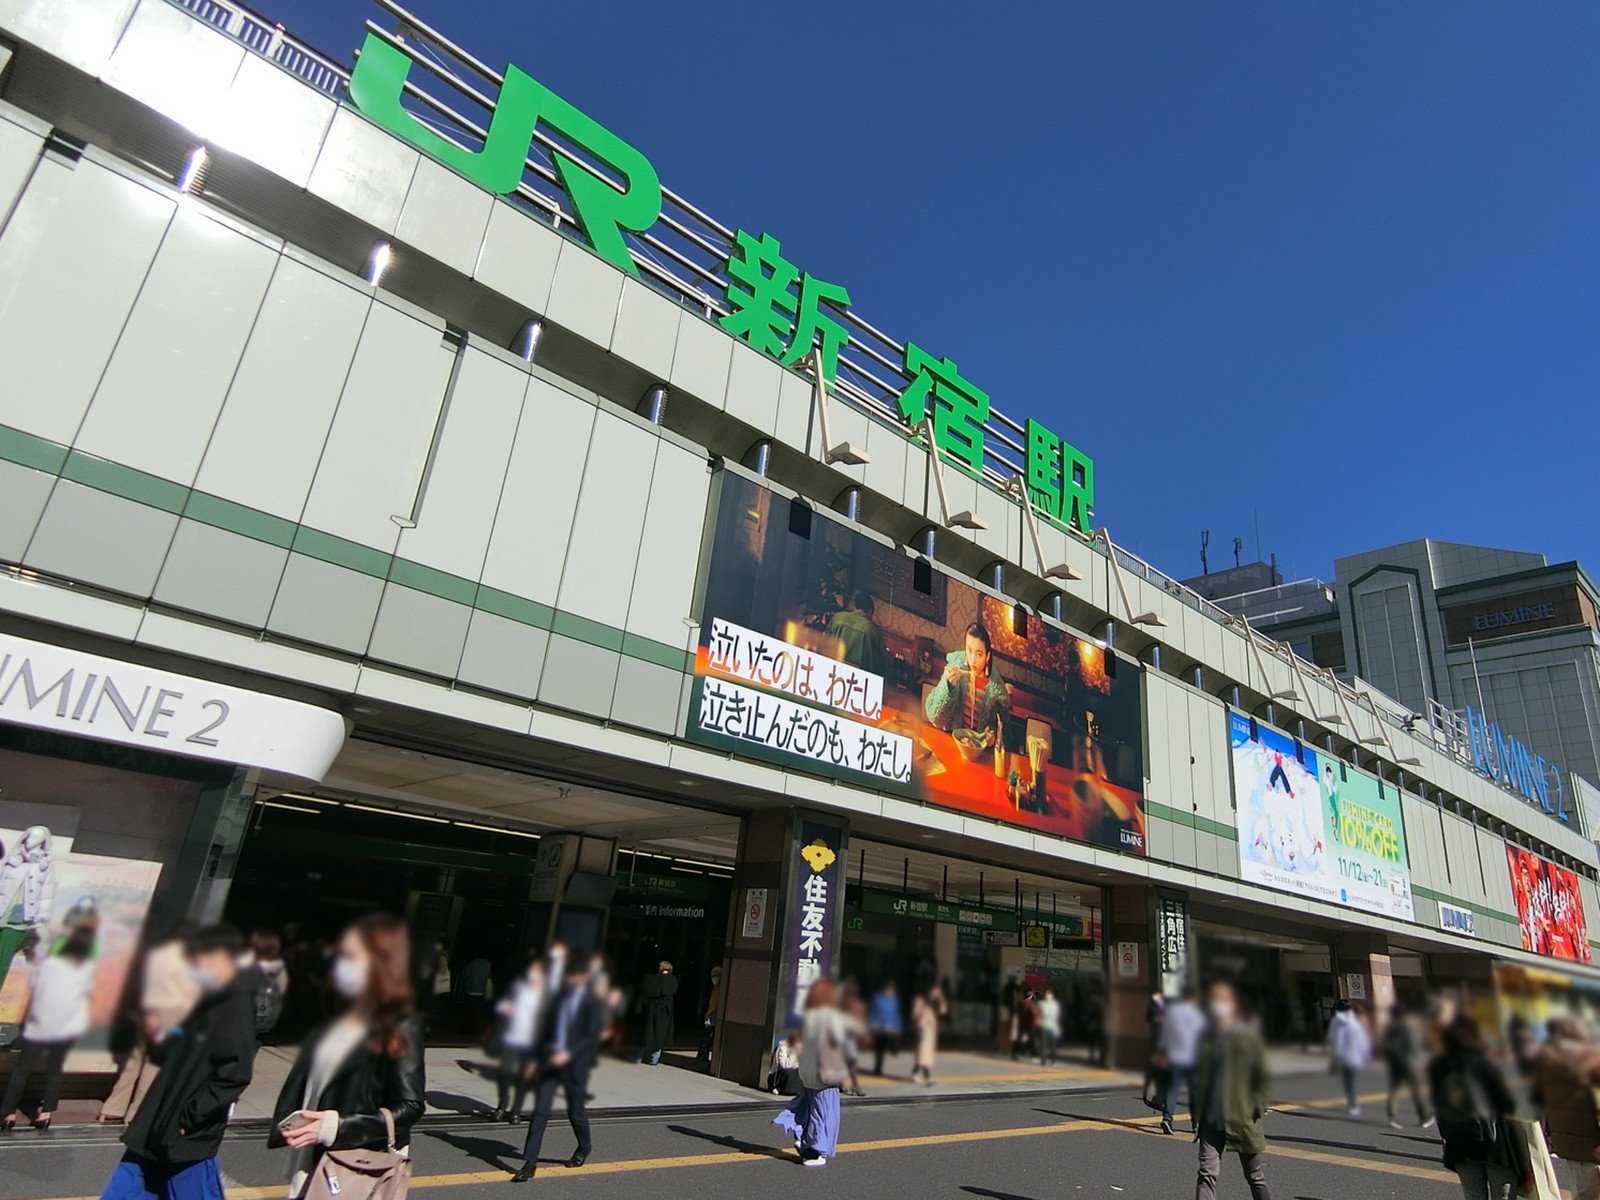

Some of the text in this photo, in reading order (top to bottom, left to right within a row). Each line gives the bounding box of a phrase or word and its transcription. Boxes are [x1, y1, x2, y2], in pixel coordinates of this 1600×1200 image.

[347, 30, 1095, 536] JR 新宿駅
[1473, 602, 1556, 631] LUMINE
[707, 622, 882, 720] 泣いたのは、わたし。
[185, 697, 231, 747] 2
[698, 681, 912, 783] 泣き止んだのも、わたし。
[1466, 705, 1570, 821] LUMINE 2
[1341, 799, 1372, 823] LUMINE
[1120, 832, 1143, 848] LUMINE
[658, 904, 706, 918] Information
[893, 898, 908, 911] JR
[847, 916, 864, 930] JR
